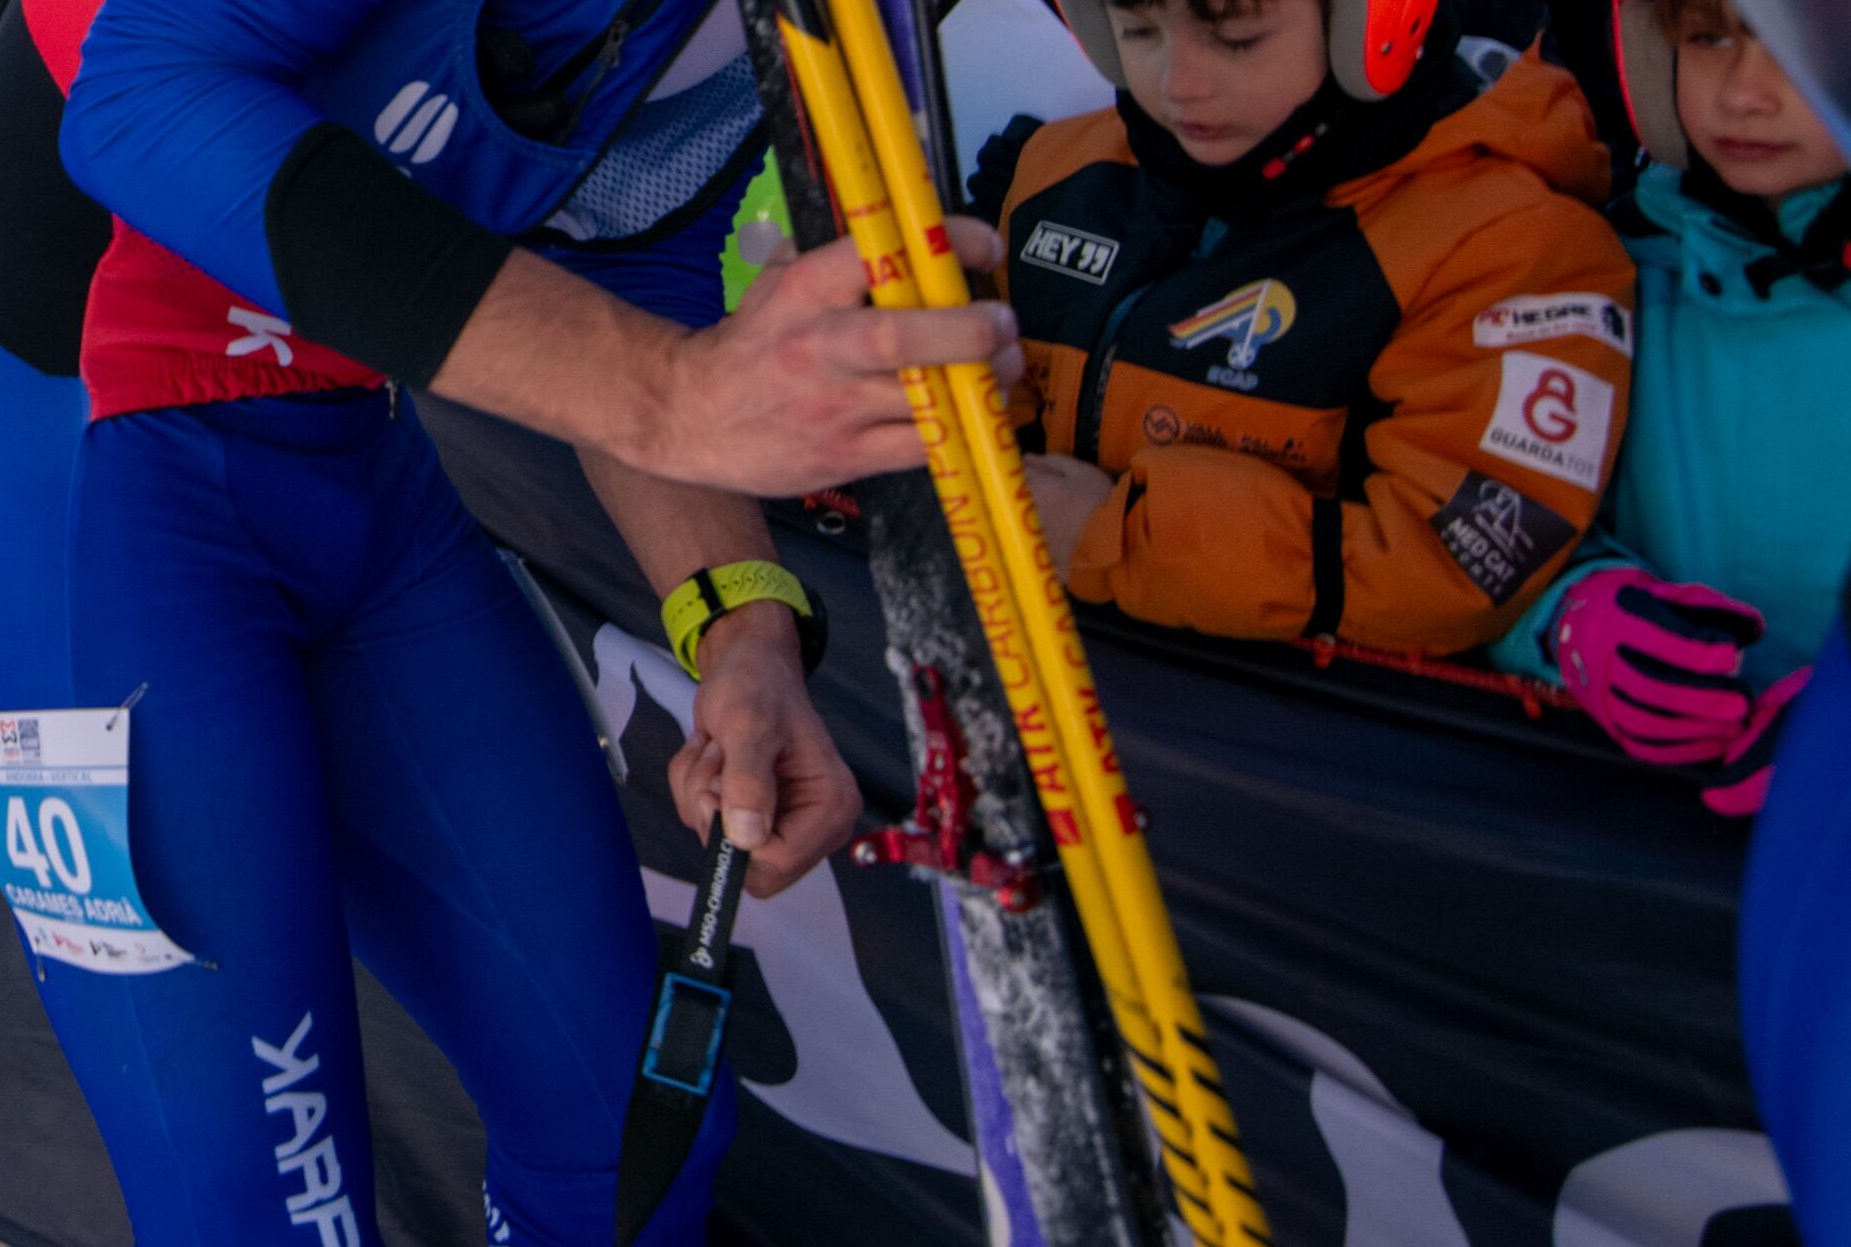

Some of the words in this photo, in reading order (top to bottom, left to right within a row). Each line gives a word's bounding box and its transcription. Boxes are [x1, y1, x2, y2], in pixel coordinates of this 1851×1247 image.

[1028, 229, 1080, 266] HEY
[943, 494, 1031, 692] CARBON
[6, 796, 92, 896] 40
[5, 882, 84, 921] CARAMES
